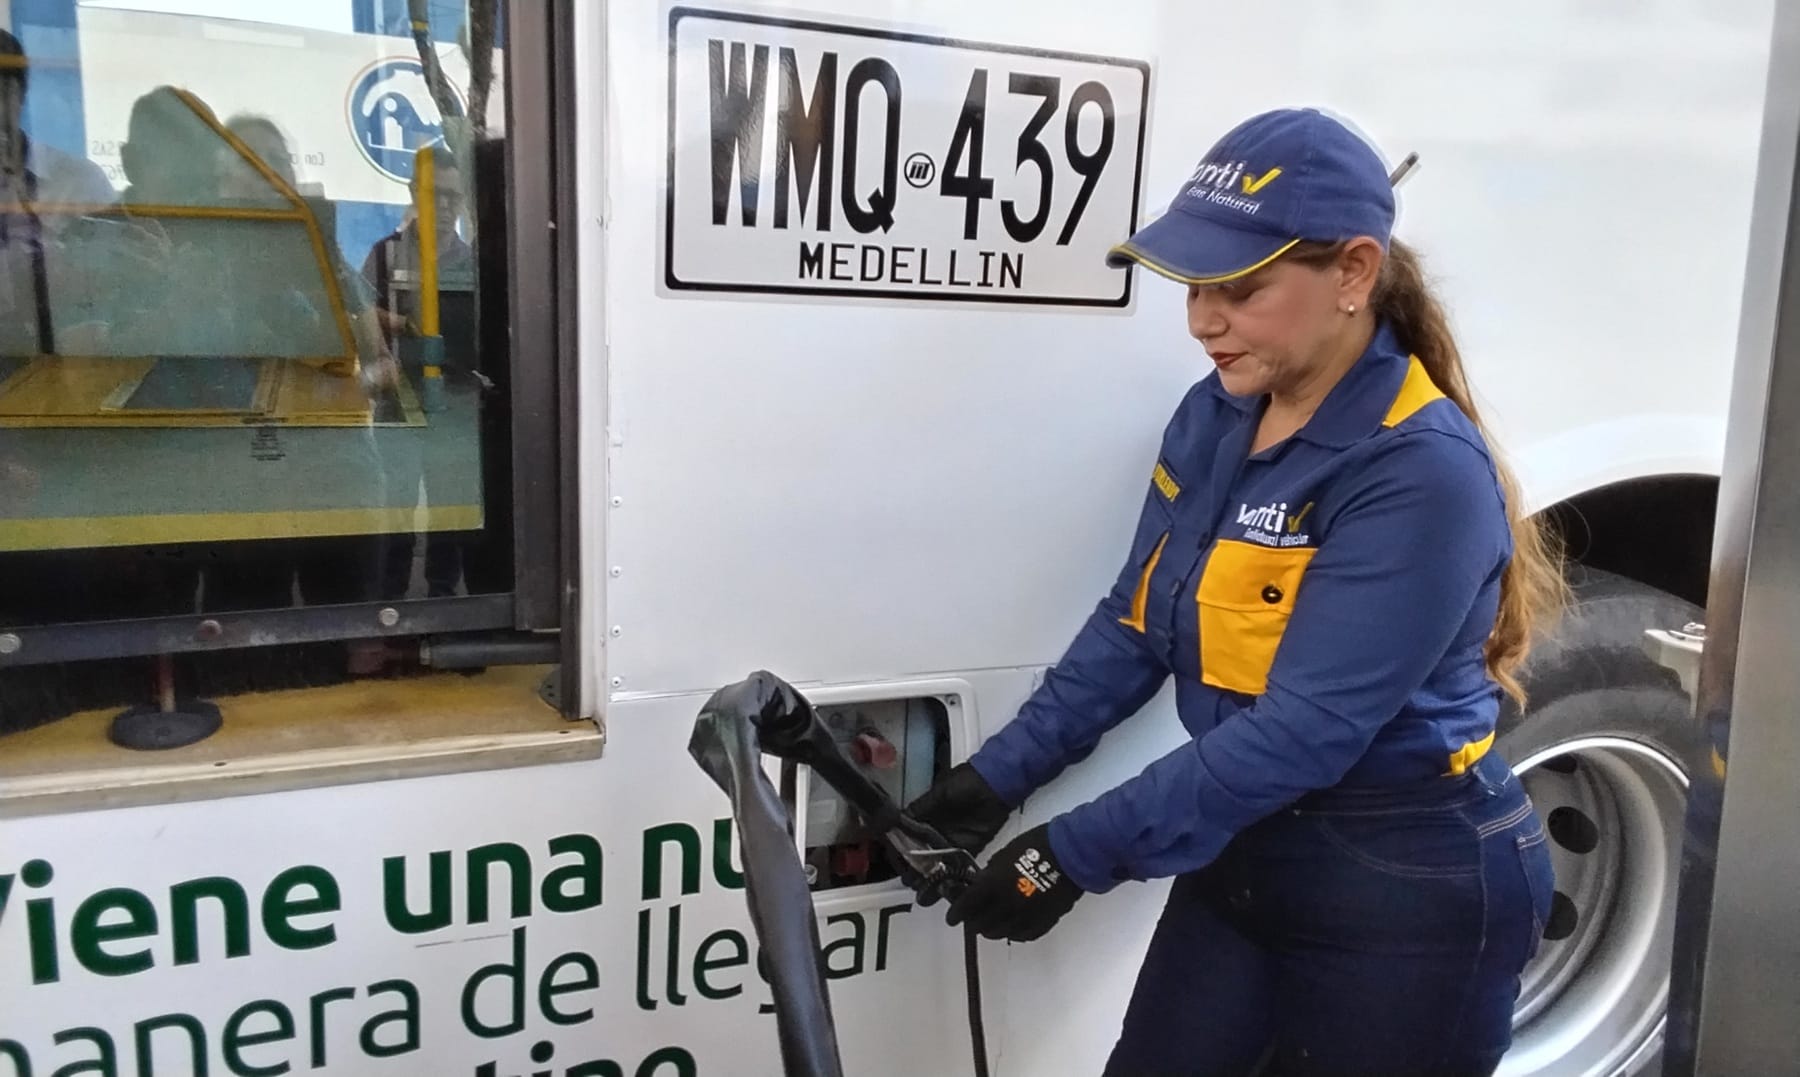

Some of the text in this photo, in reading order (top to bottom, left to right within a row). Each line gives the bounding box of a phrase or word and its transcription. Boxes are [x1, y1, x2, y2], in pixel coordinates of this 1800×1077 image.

[709, 39, 901, 234] WMQ
[940, 68, 1115, 245] 439
[1206, 190, 1261, 215] Natural
[799, 241, 1024, 289] MEDELLIN
[383, 834, 603, 934] una
[0, 903, 912, 1077] anera de llear
